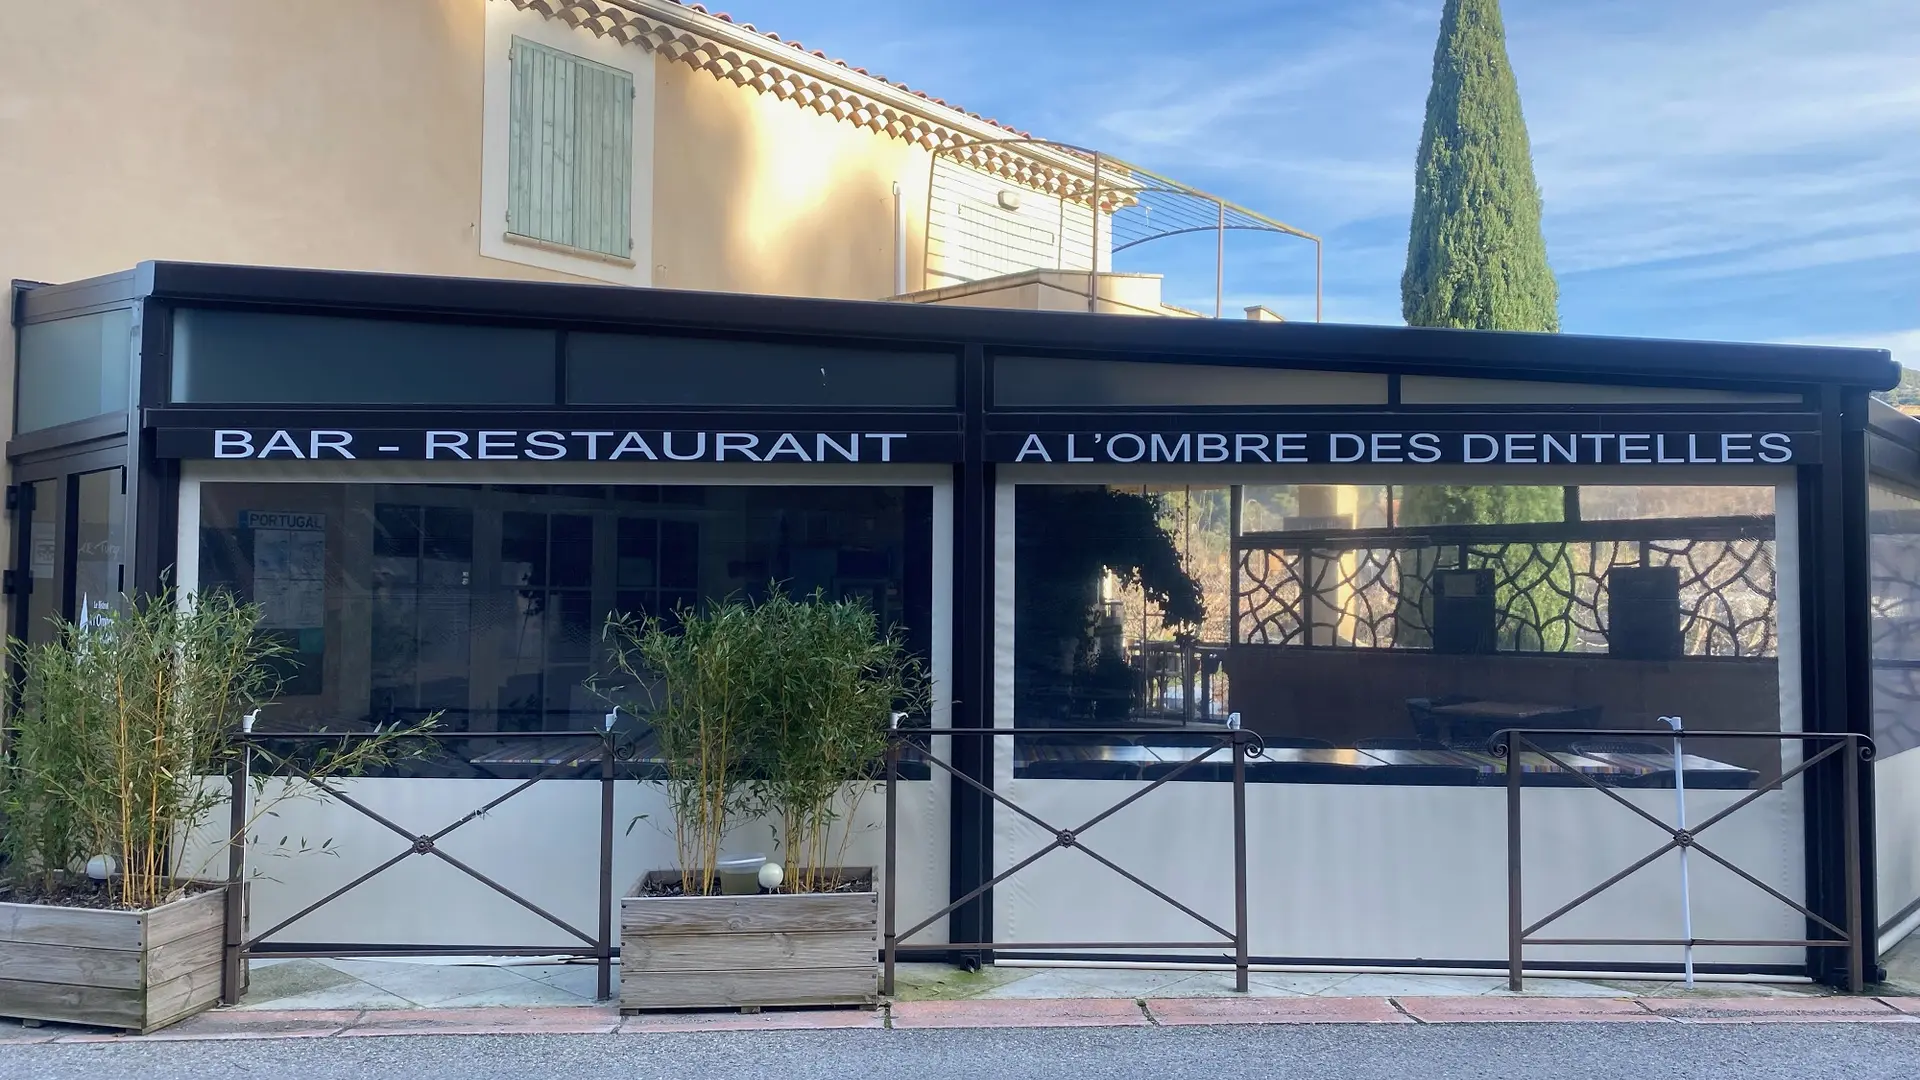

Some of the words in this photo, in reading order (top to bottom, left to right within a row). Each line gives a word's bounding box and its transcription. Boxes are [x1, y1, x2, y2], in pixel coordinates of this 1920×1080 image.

[214, 430, 356, 459] BAR
[425, 431, 908, 461] RESTAURANT
[1015, 434, 1052, 462] A
[1067, 433, 1308, 462] L'OMBRE
[1330, 433, 1443, 463] DES
[1463, 433, 1794, 463] DENTELLES
[250, 513, 321, 529] PORTUGAL
